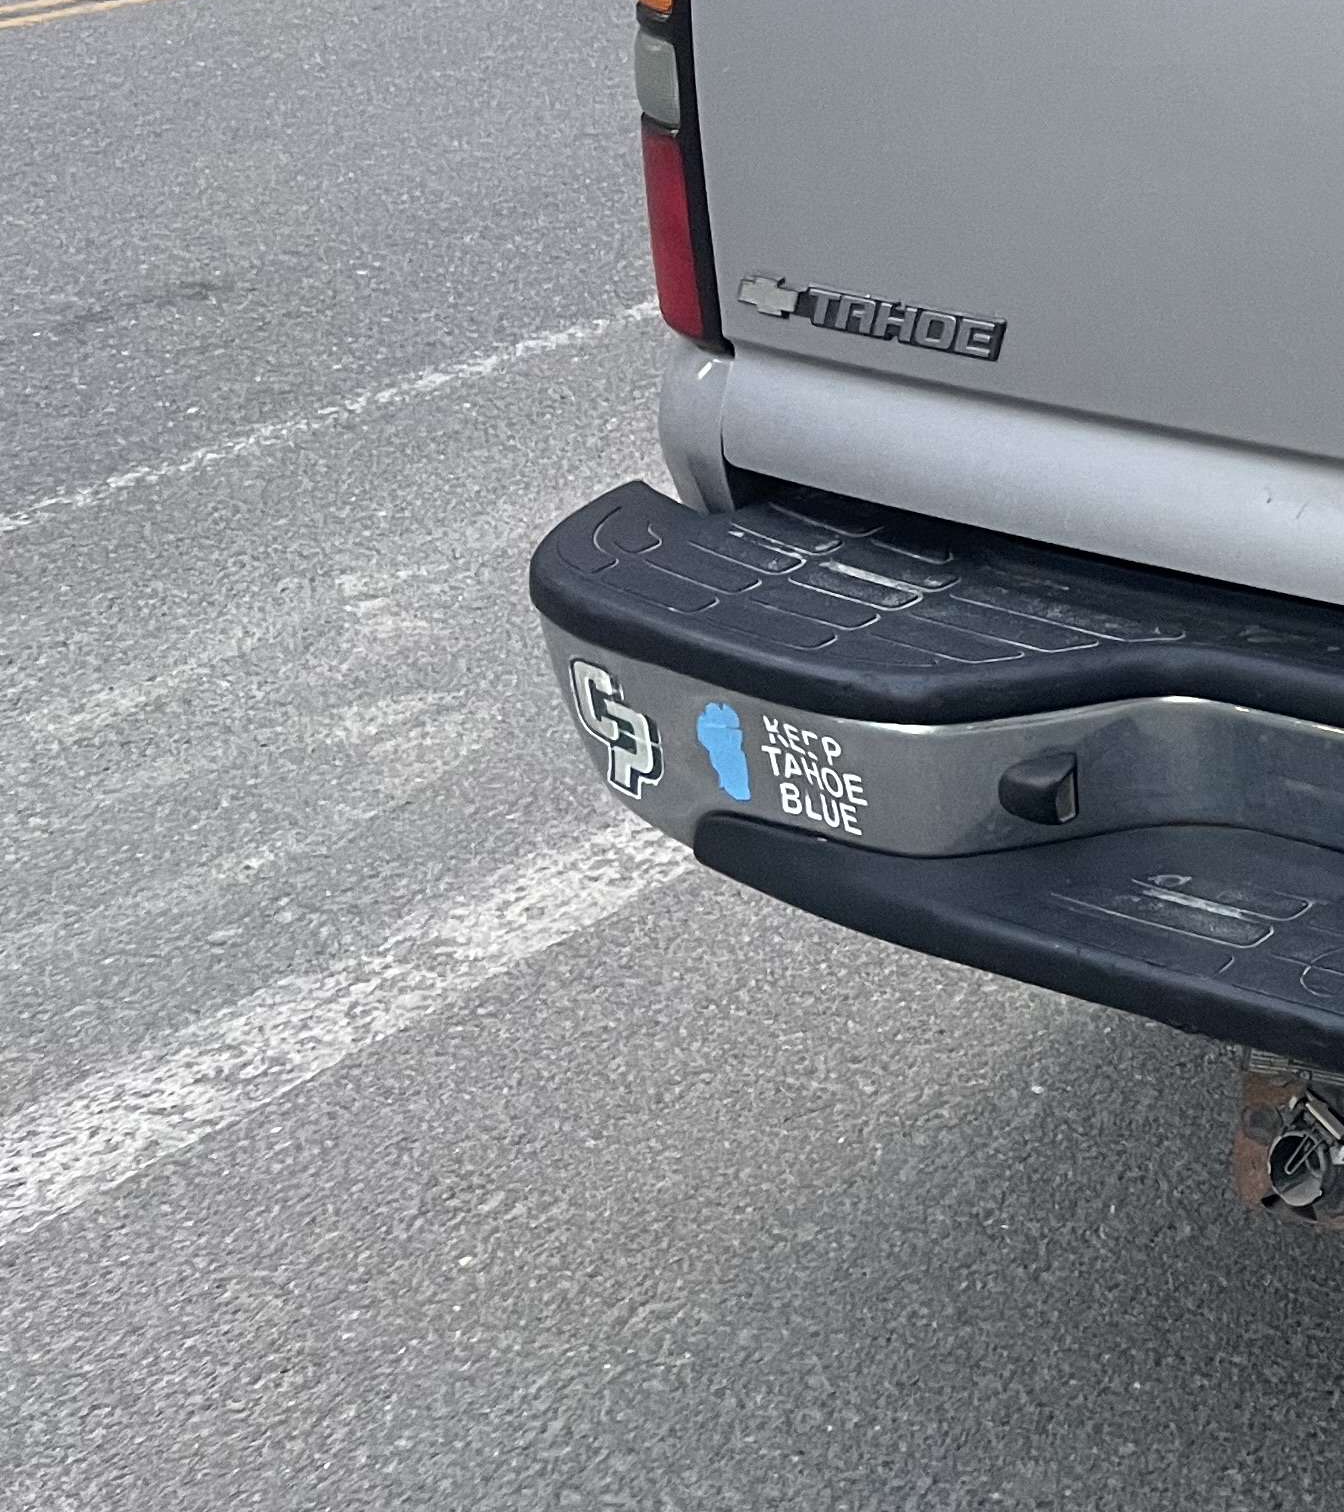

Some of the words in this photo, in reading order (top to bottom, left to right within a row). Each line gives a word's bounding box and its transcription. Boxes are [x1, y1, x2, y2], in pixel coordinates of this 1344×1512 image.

[807, 287, 1001, 360] TAHOE
[761, 745, 868, 806] TAHOE
[779, 782, 863, 836] BLUE
